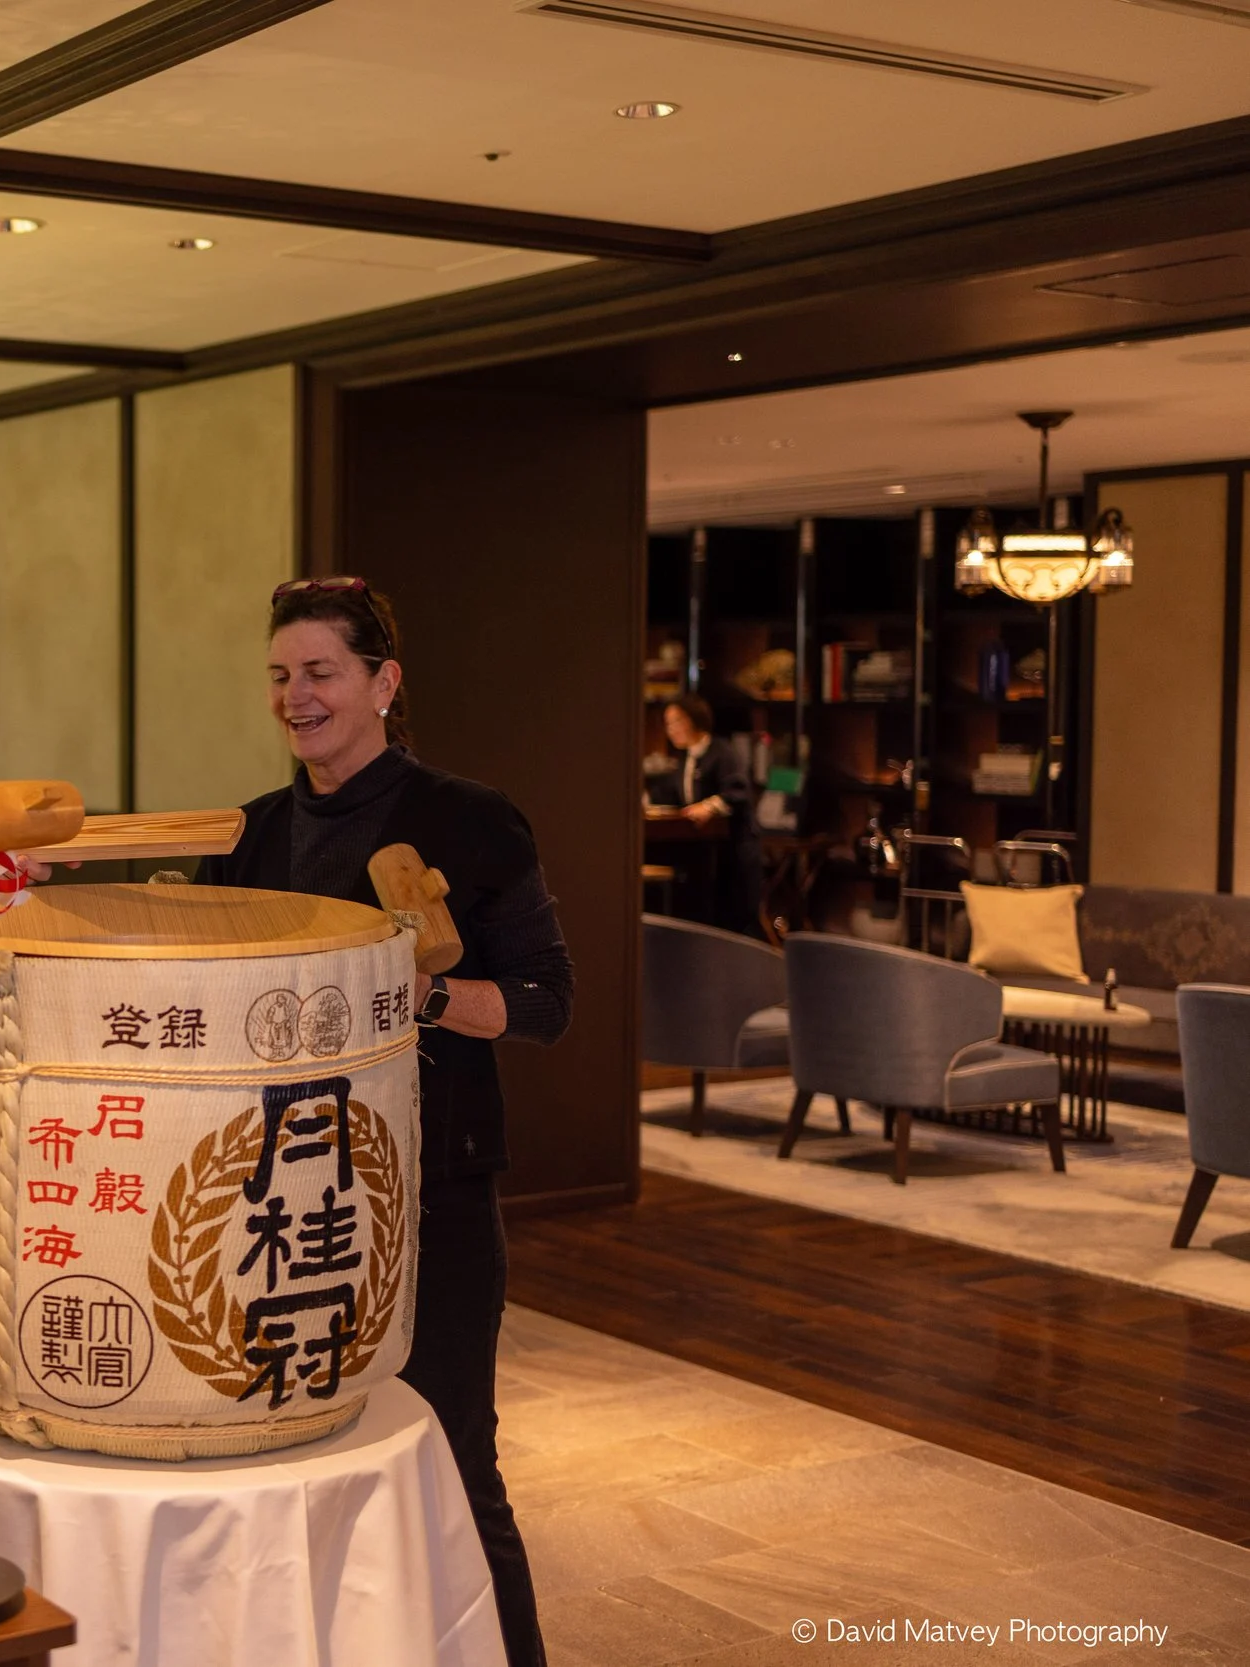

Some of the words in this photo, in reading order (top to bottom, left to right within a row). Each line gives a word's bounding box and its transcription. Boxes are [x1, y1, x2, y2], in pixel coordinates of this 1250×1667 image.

[101, 1002, 208, 1050] 登録
[236, 1076, 362, 1409] 月桂冠
